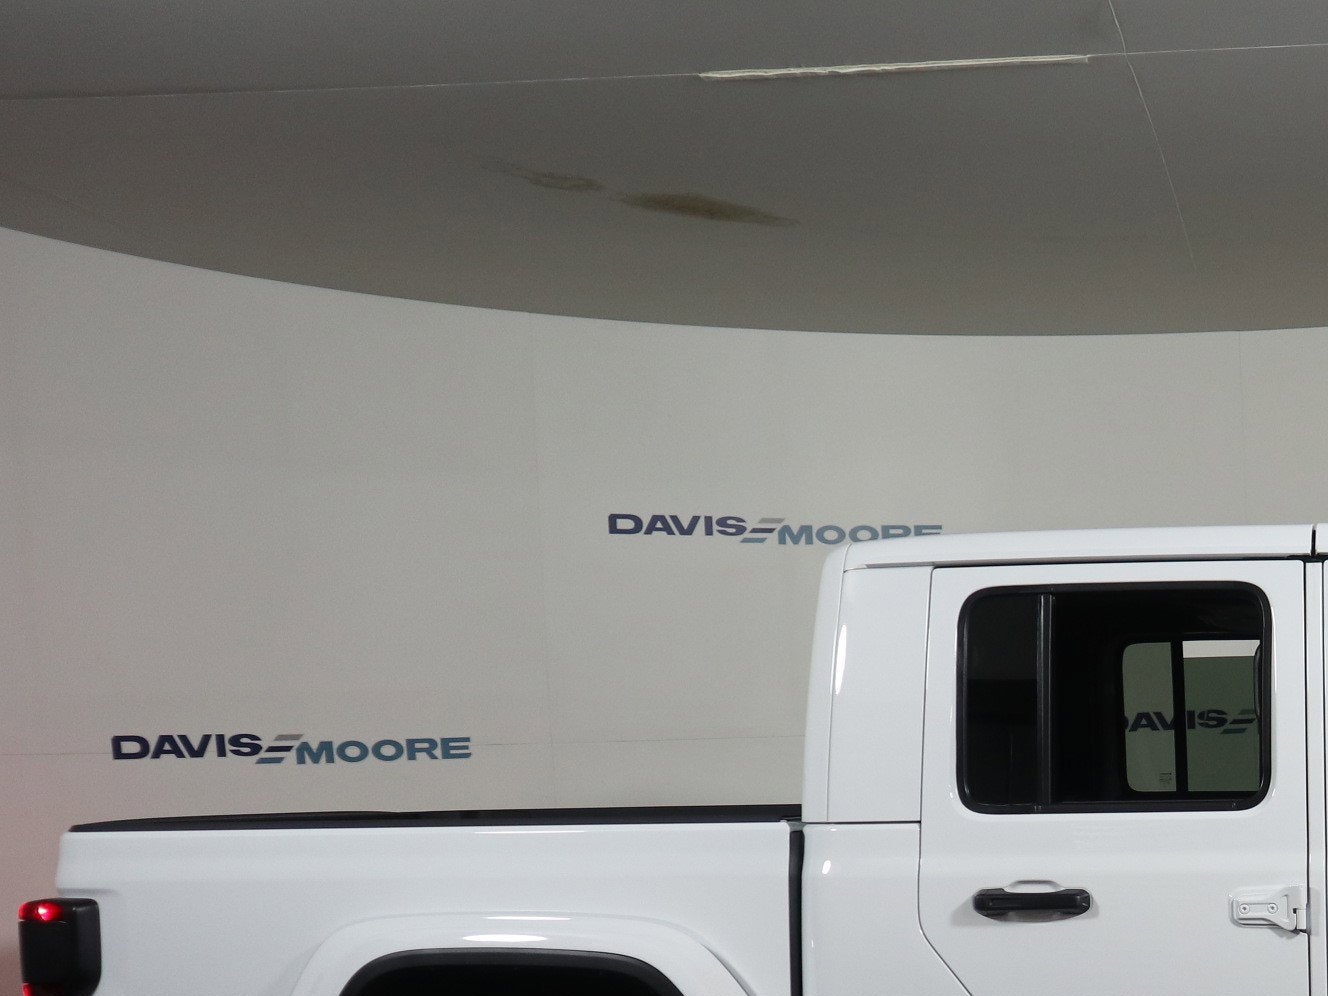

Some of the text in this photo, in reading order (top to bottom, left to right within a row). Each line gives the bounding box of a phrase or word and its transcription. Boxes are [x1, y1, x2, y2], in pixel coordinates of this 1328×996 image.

[607, 513, 747, 537] DAVIS
[110, 733, 473, 765] DAVIS MOORE
